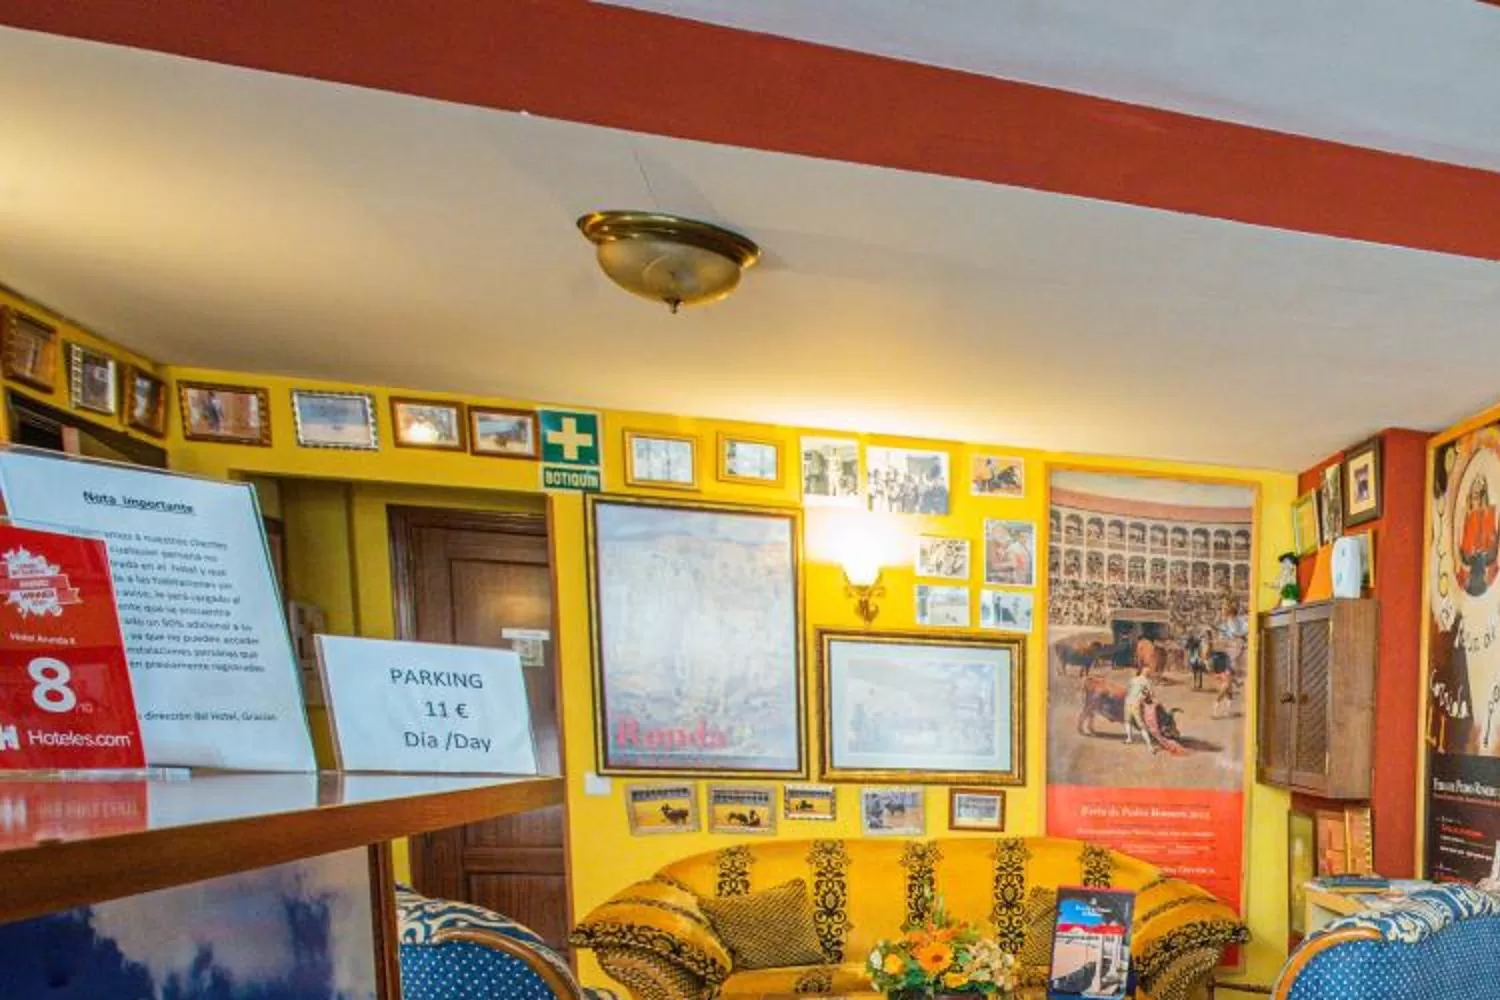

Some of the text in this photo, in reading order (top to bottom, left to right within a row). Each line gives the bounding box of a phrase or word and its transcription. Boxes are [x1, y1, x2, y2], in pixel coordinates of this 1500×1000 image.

[83, 490, 117, 506] Nota
[27, 657, 77, 713] 8
[390, 668, 483, 689] PARKING
[425, 701, 469, 719] 11 €
[27, 731, 131, 748] Hoteles.com
